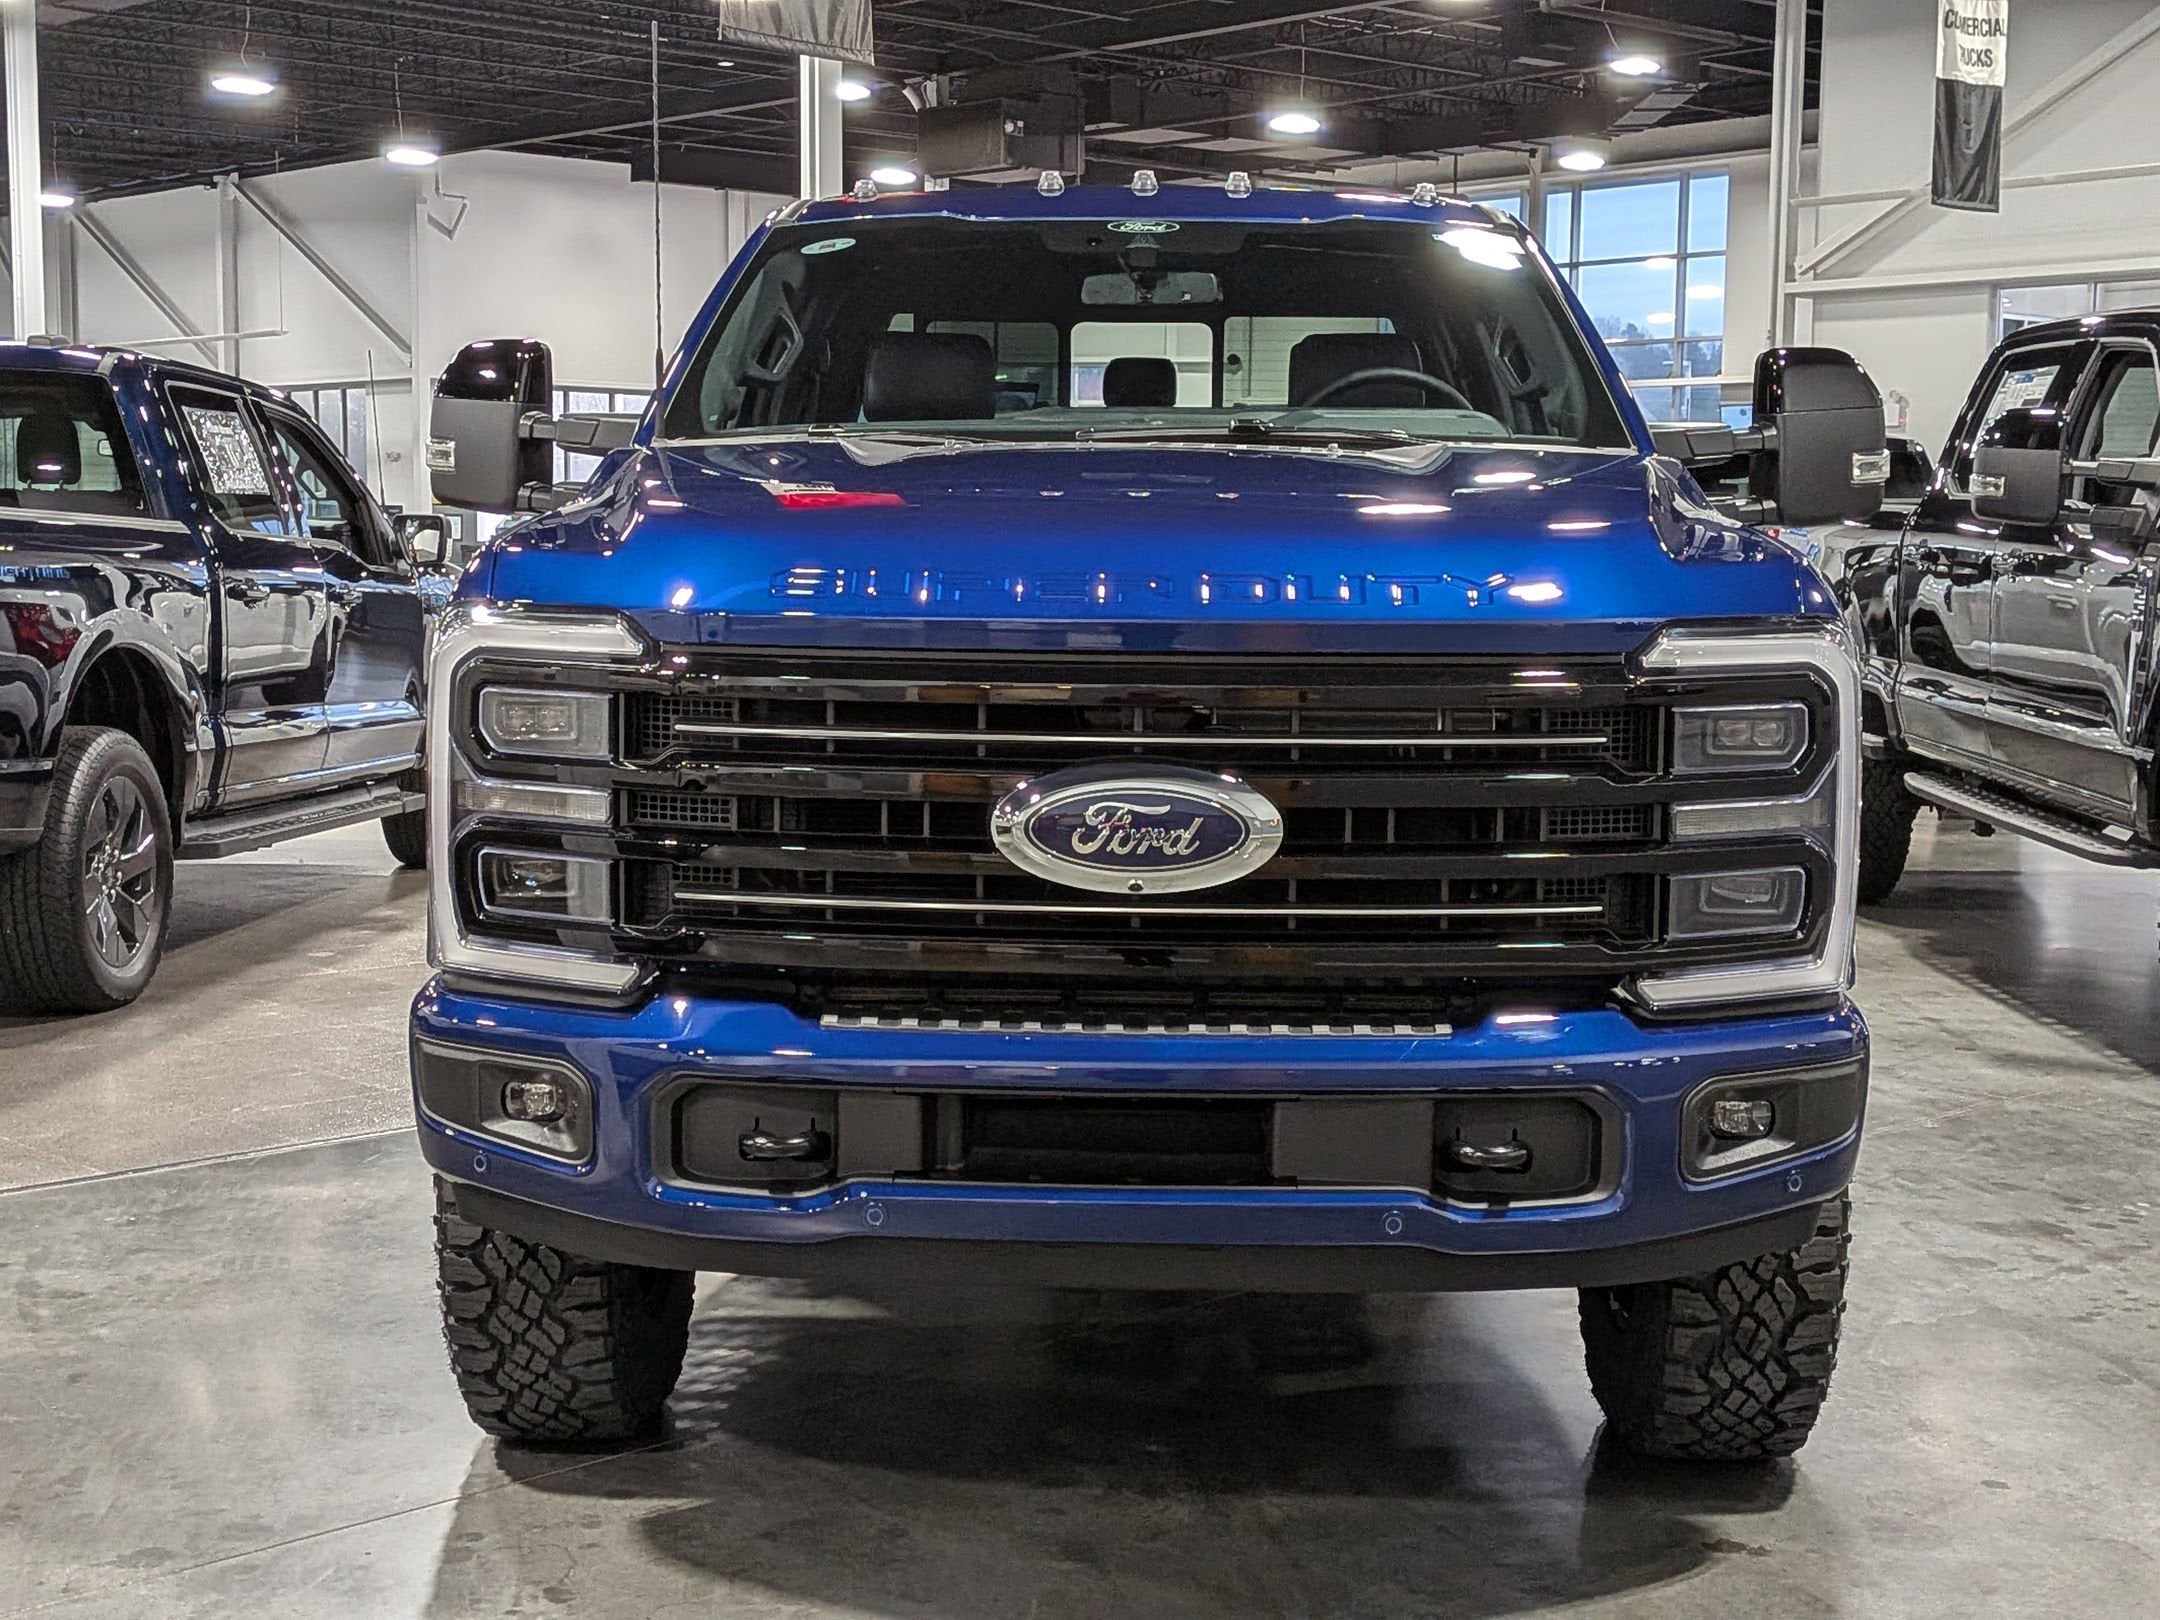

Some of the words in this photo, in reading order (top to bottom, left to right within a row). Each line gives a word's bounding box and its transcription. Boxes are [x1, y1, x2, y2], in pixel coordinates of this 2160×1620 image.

[1120, 221, 1167, 232] Ford
[769, 567, 1175, 602] SUPER
[1200, 572, 1514, 606] DUTY
[1071, 801, 1204, 855] Ford
